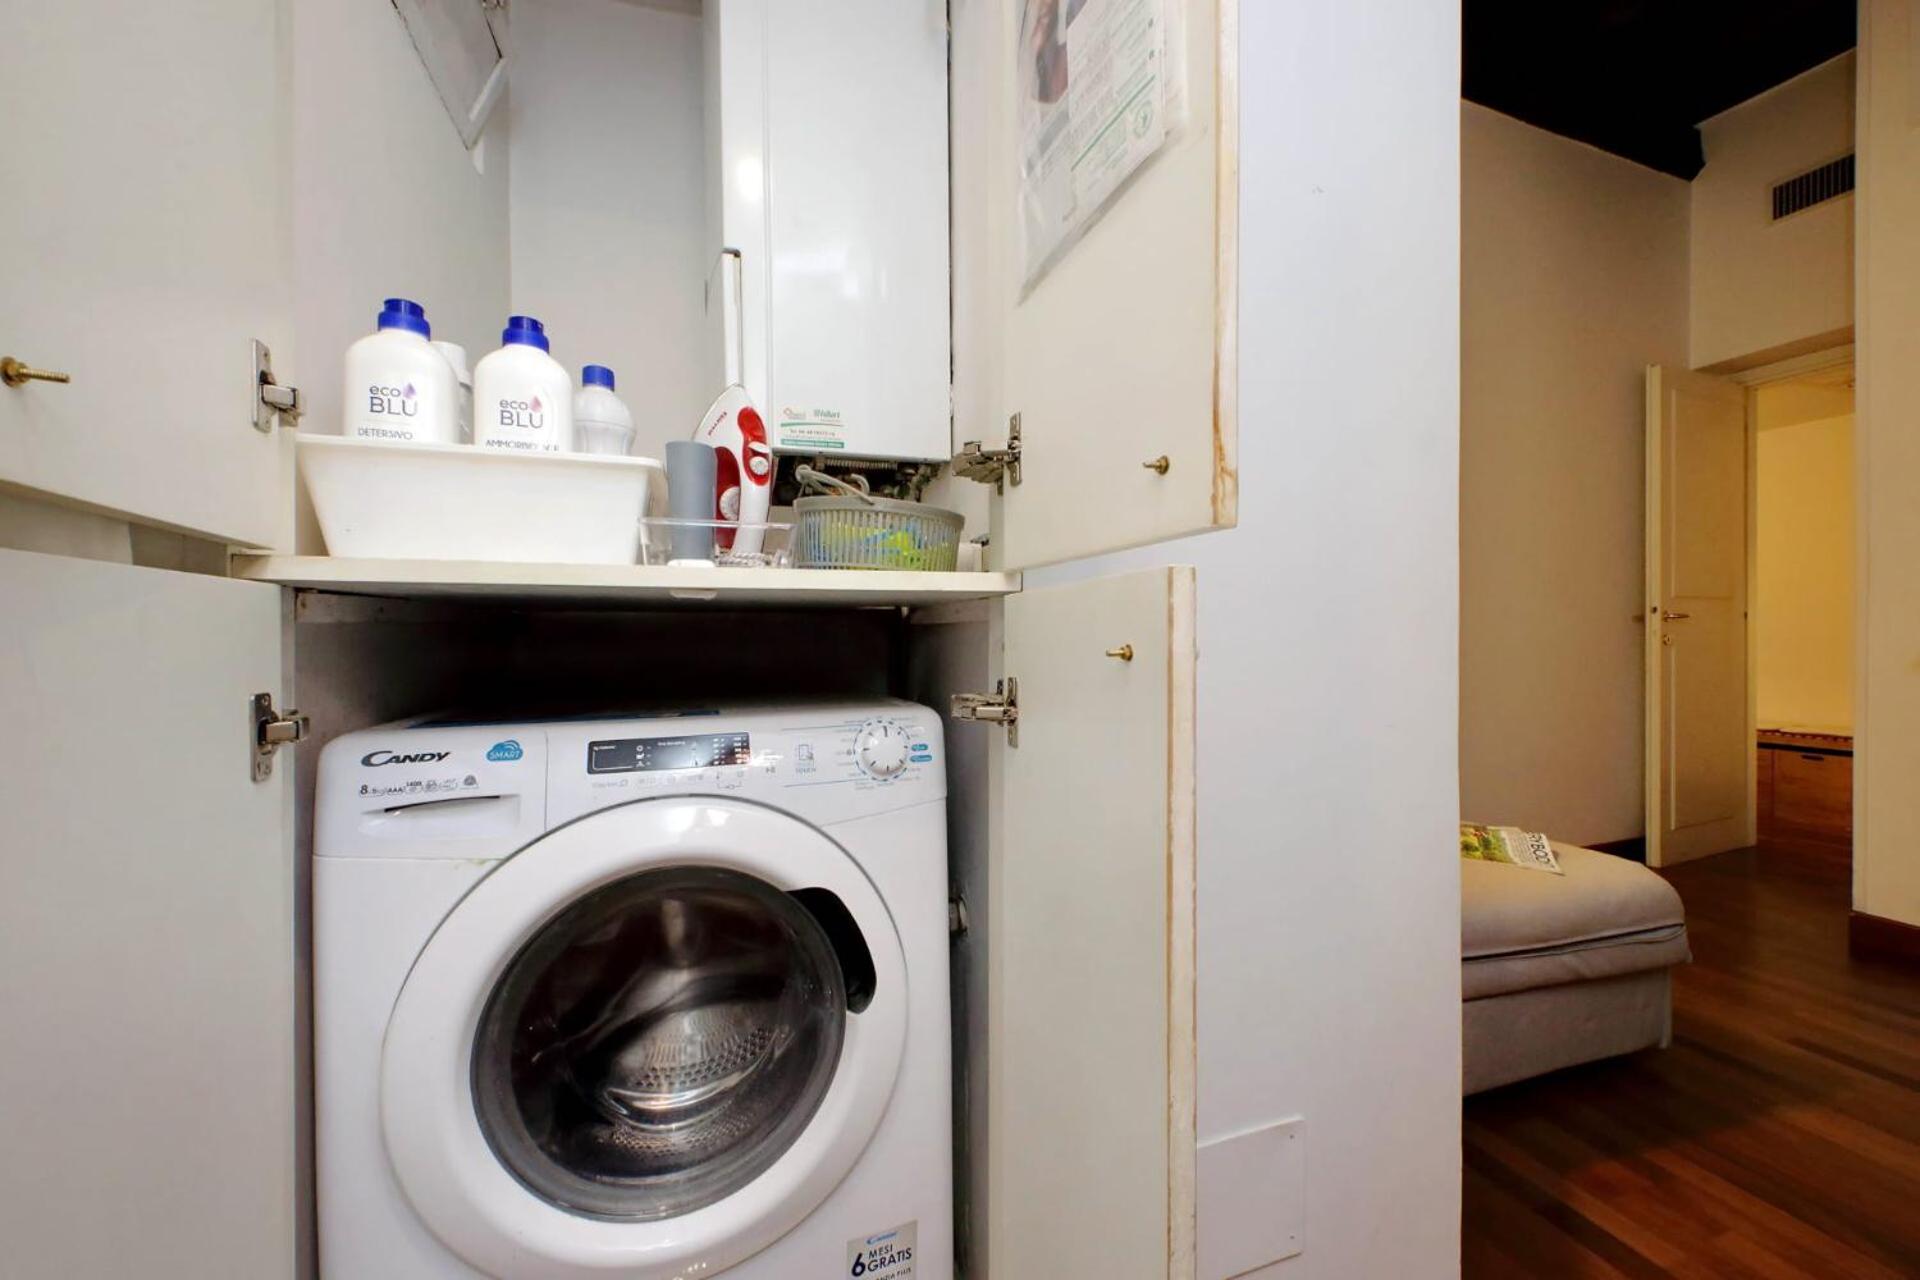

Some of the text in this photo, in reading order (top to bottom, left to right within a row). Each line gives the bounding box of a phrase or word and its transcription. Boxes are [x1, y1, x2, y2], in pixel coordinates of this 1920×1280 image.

[369, 385, 401, 397] eco
[369, 396, 418, 416] BLU
[499, 399, 528, 410] eco
[500, 409, 543, 428] BLU
[357, 427, 413, 441] DETERSIVO
[360, 750, 450, 767] CANDY
[489, 749, 521, 760] SMART
[868, 1243, 893, 1260] MESI
[851, 1247, 912, 1277] 6 GRATIS
